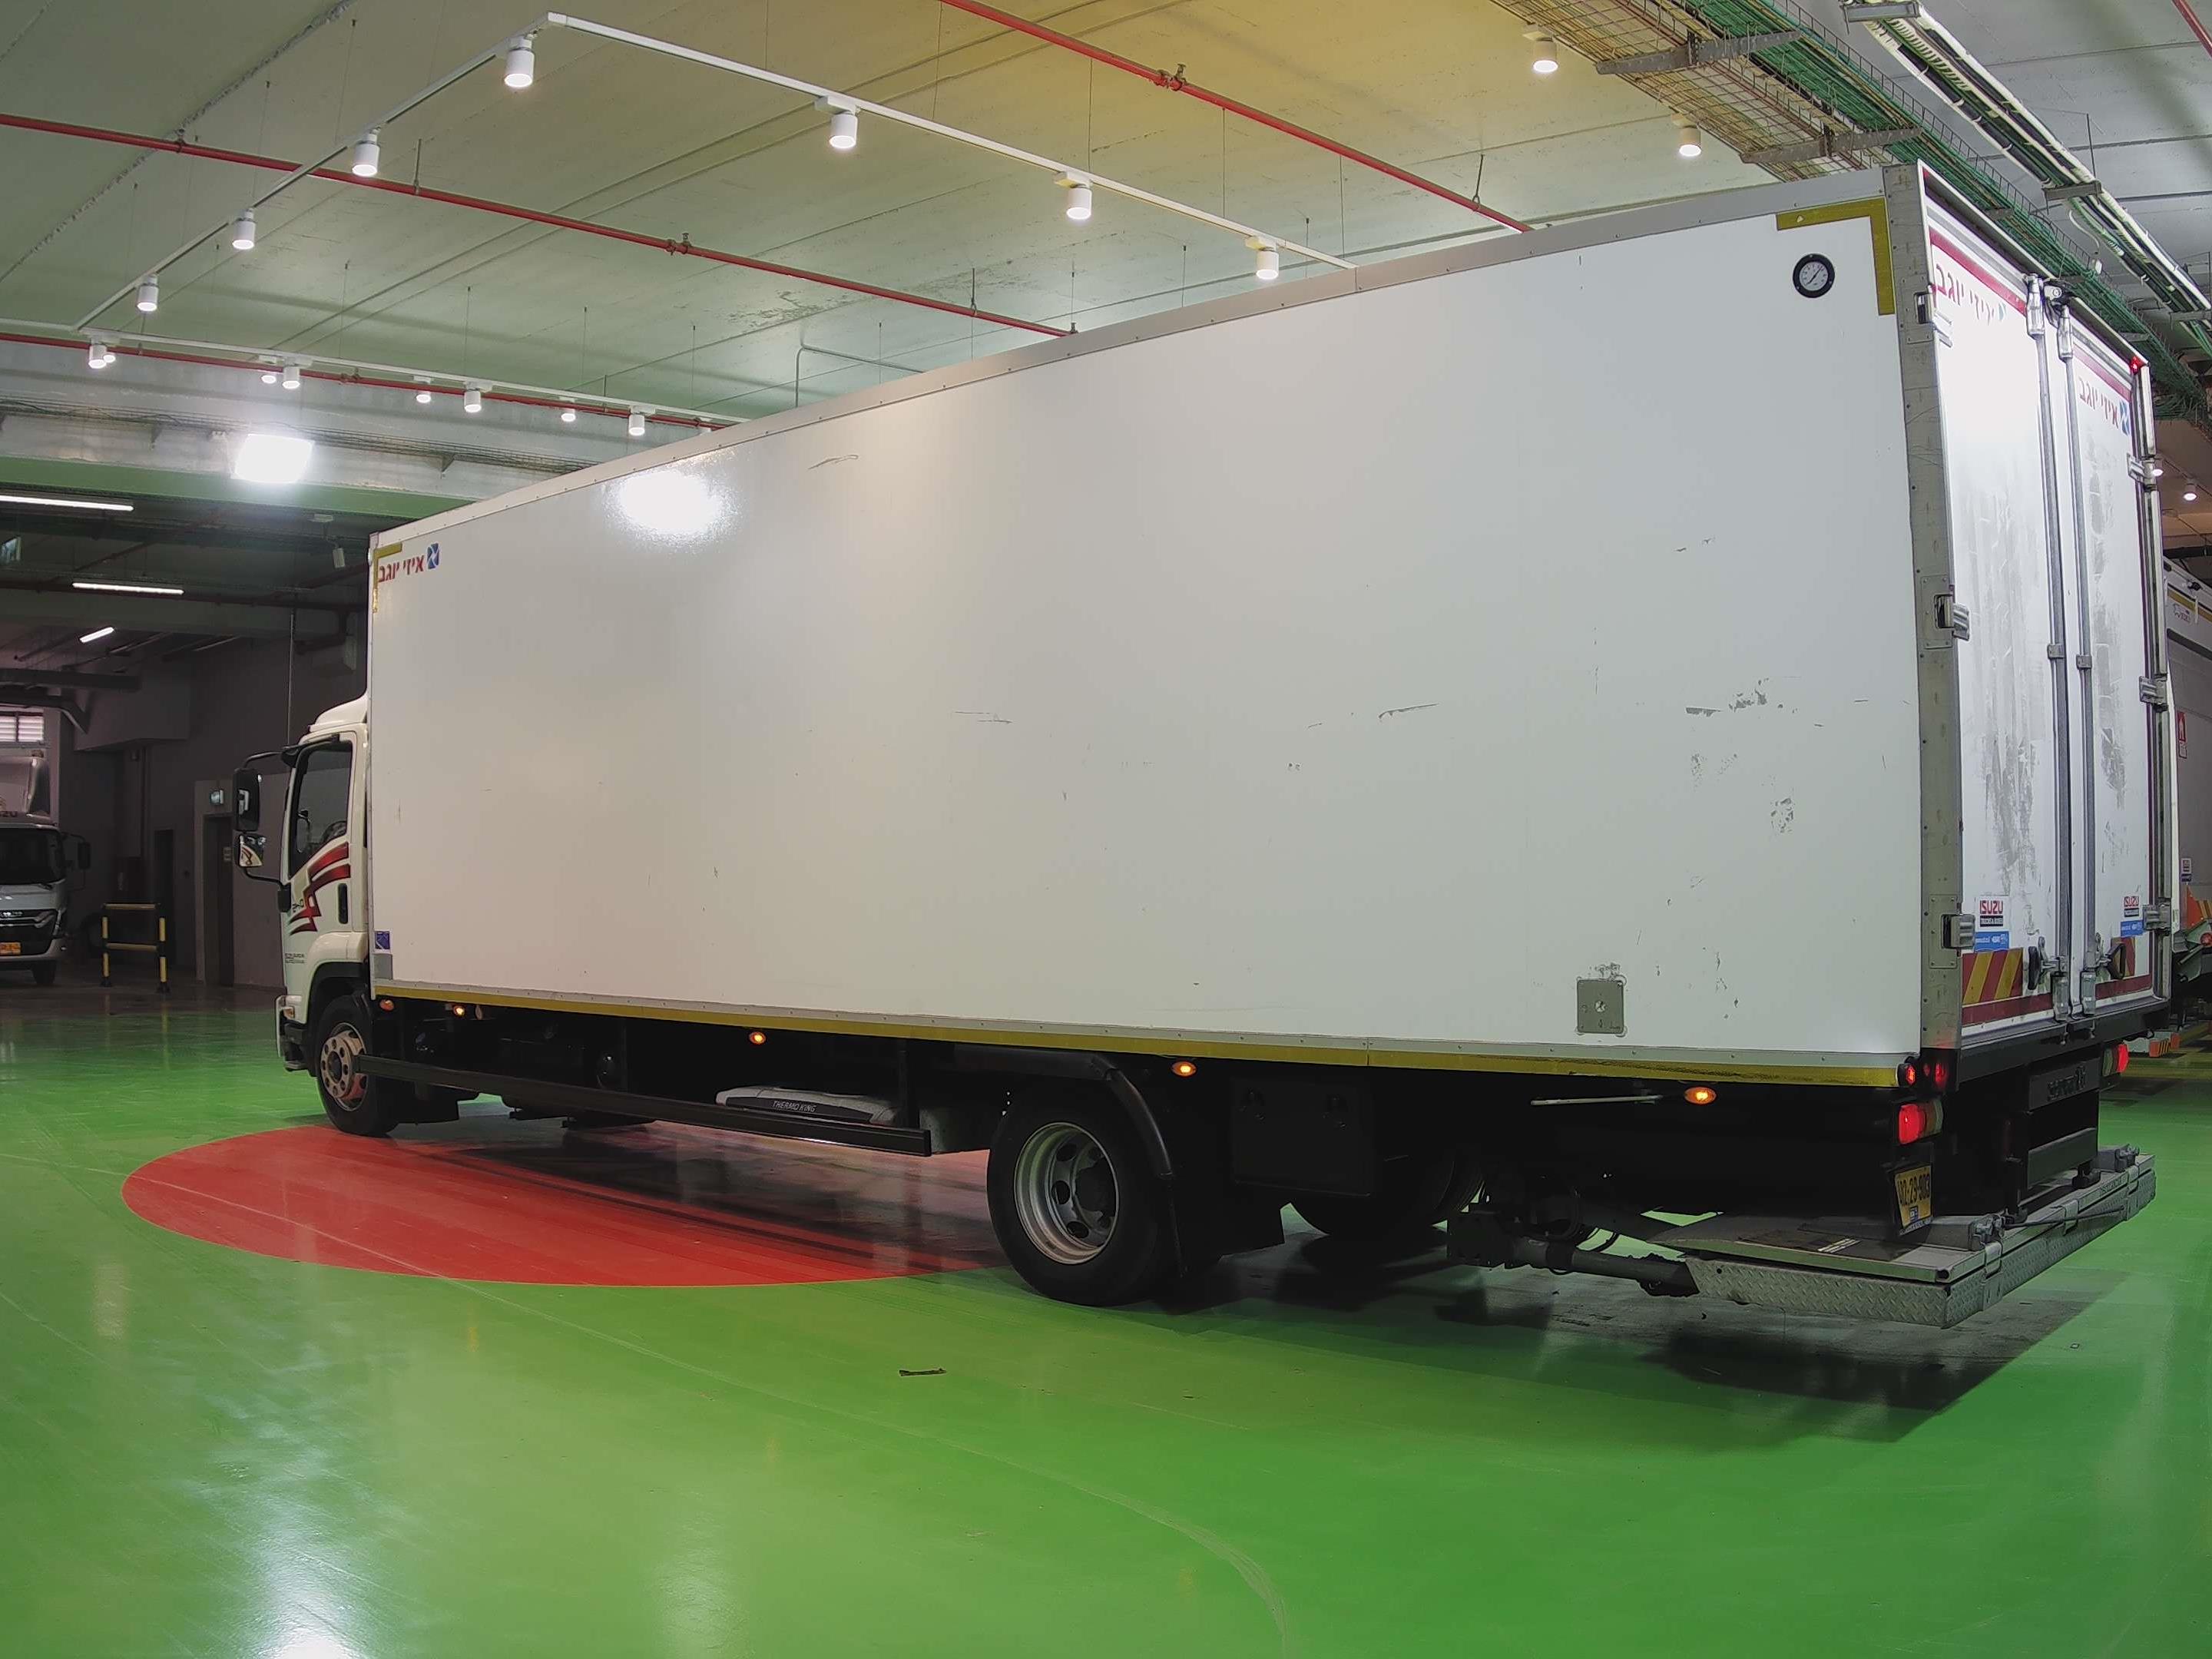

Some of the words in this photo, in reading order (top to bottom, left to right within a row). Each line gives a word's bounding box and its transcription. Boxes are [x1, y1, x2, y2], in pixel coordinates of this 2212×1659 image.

[378, 561, 400, 583] יוגב
[402, 555, 425, 575] איזי
[1979, 899, 2004, 914] ISUZU
[772, 1100, 800, 1111] THERMO
[799, 1104, 817, 1113] KING
